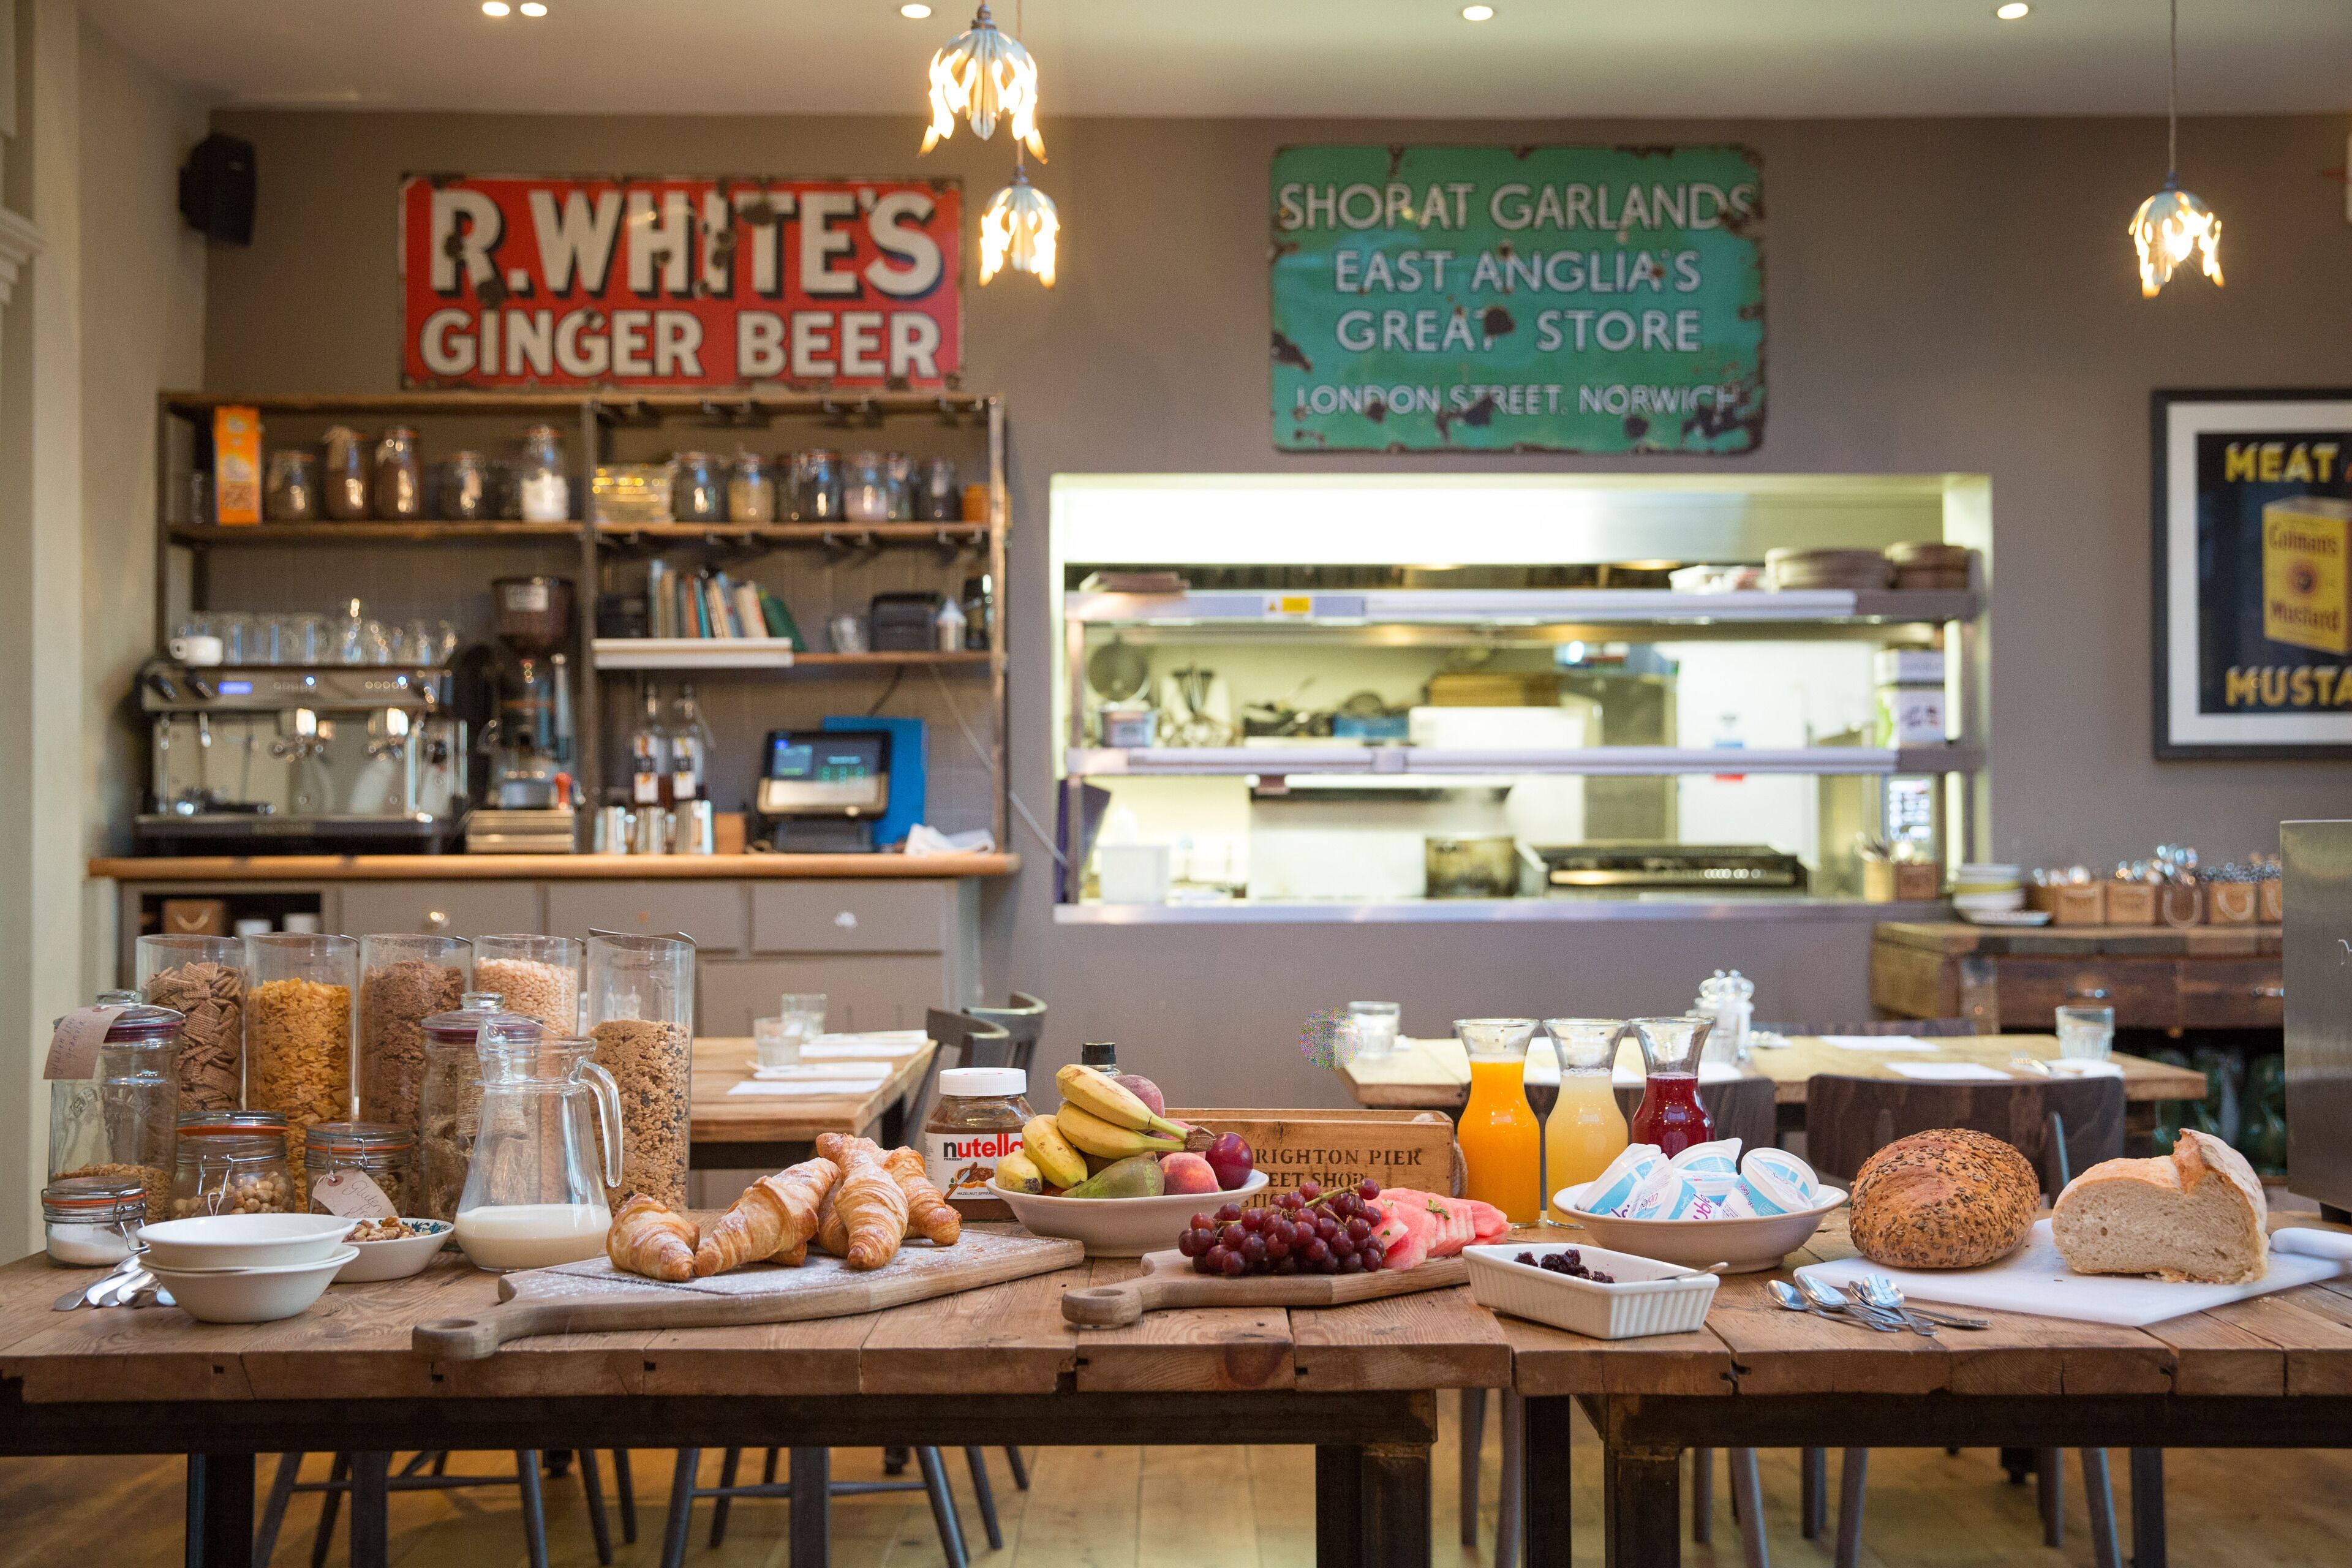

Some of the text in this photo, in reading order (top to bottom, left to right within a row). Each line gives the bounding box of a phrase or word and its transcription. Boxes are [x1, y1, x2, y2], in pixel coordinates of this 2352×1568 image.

[1278, 183, 1756, 231] SHOP AT GARLANDS
[1335, 249, 1701, 293] EAST ANGLIA'S
[420, 308, 942, 380] GINGER BEER
[1537, 310, 1702, 353] STORE
[2224, 442, 2340, 483] MEAT
[1254, 1148, 1422, 1166] RIGHTON PIER
[342, 1180, 382, 1213] Gluten
[1265, 1172, 1305, 1187] EET
[350, 1204, 371, 1218] fre
